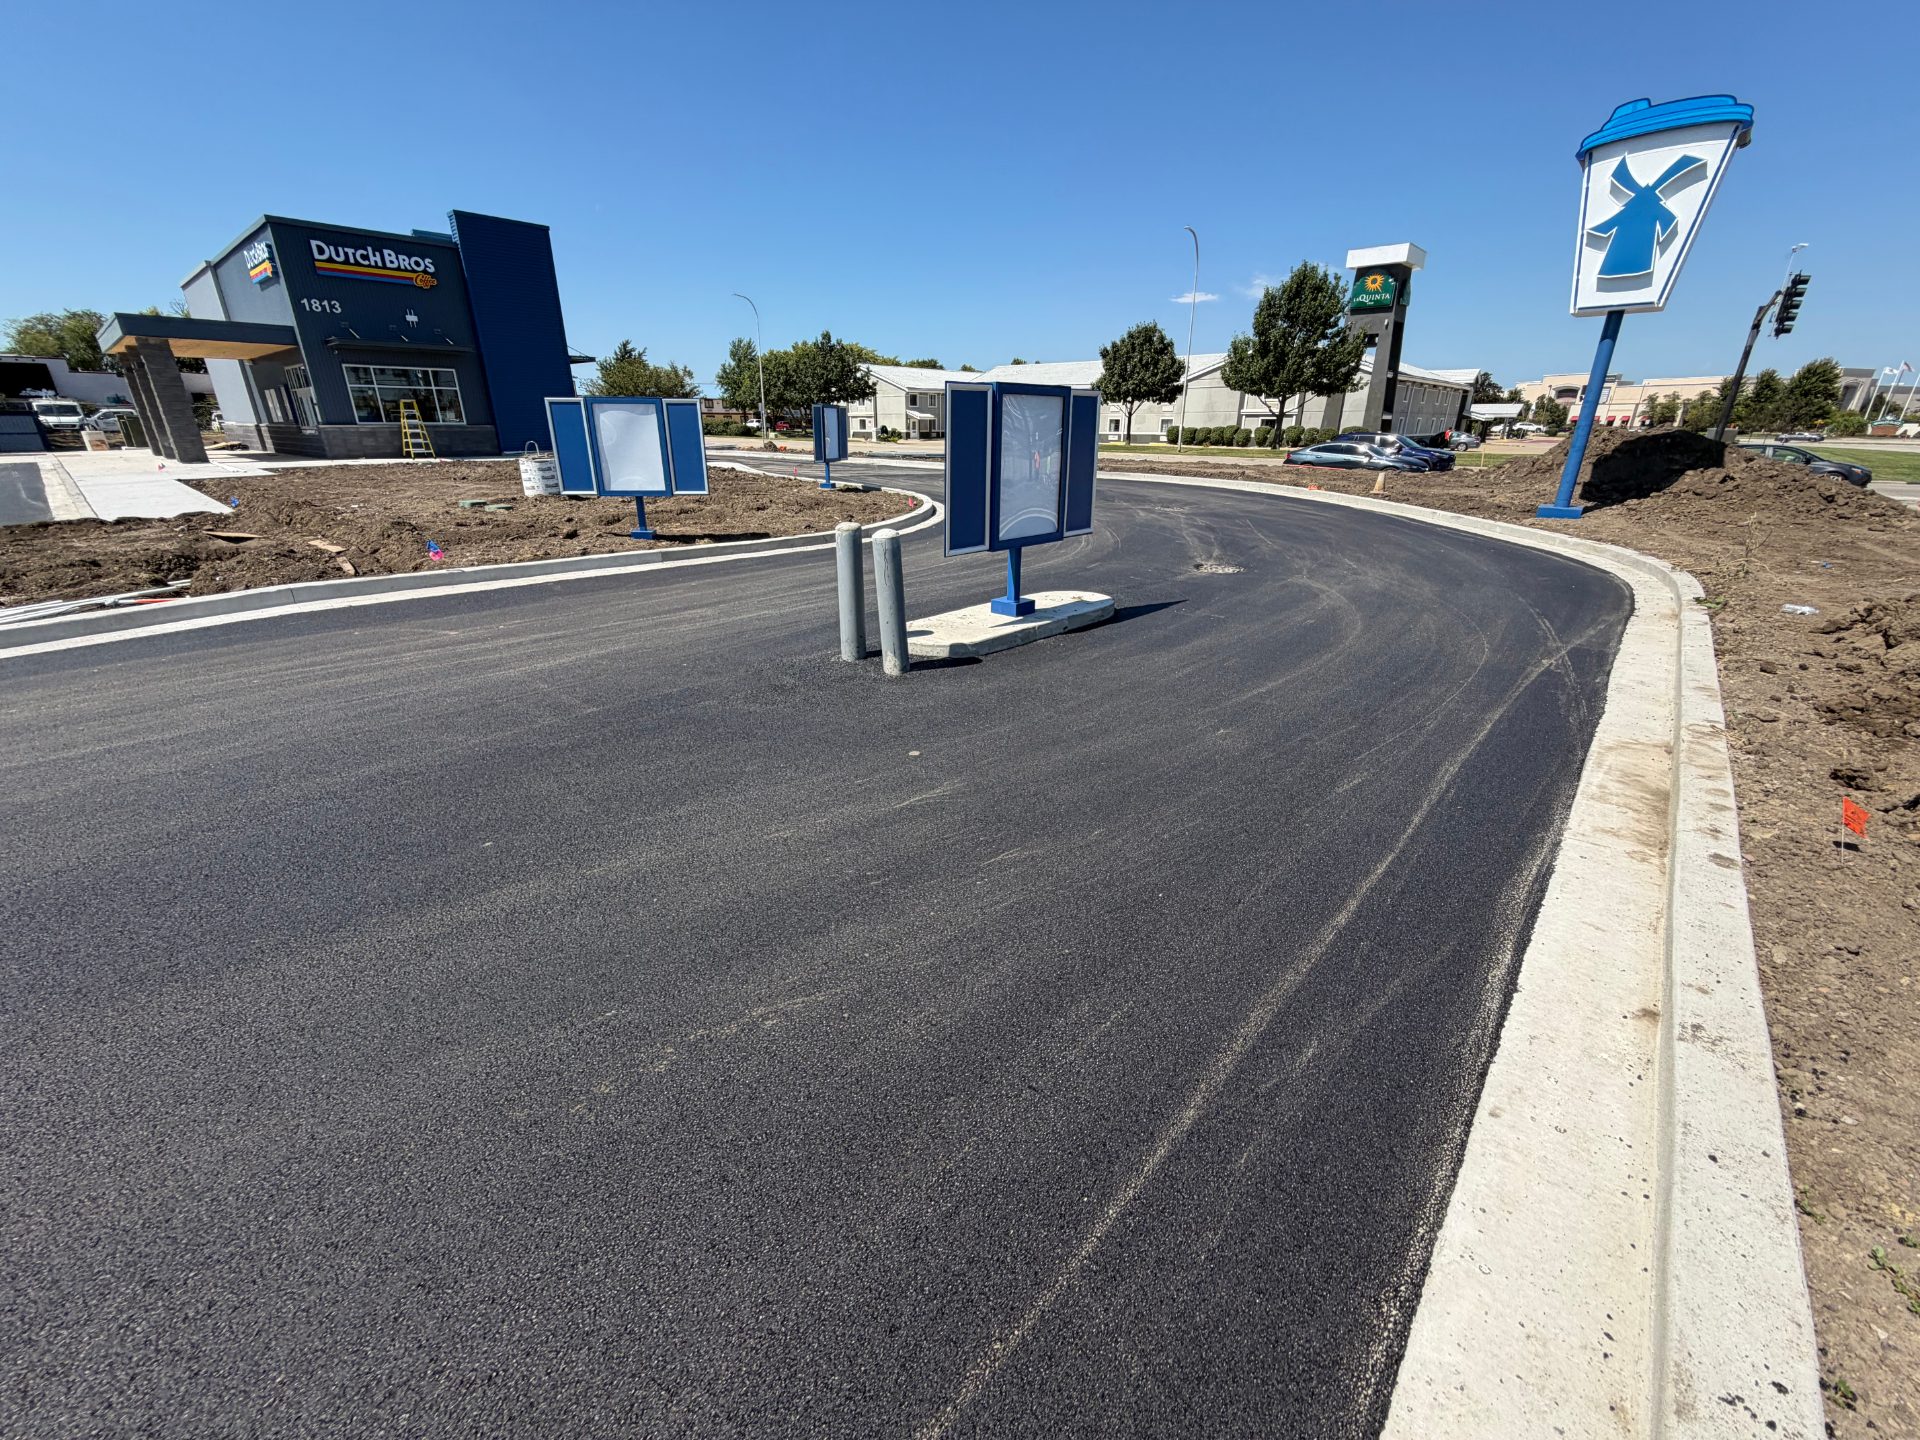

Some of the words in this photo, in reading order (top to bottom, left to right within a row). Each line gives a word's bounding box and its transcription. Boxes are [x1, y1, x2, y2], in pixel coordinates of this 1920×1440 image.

[310, 239, 382, 267] DUTCH
[382, 248, 436, 273] BROS
[414, 272, 438, 289] Coffee
[300, 297, 342, 314] 1813
[1359, 293, 1390, 303] QUINTA
